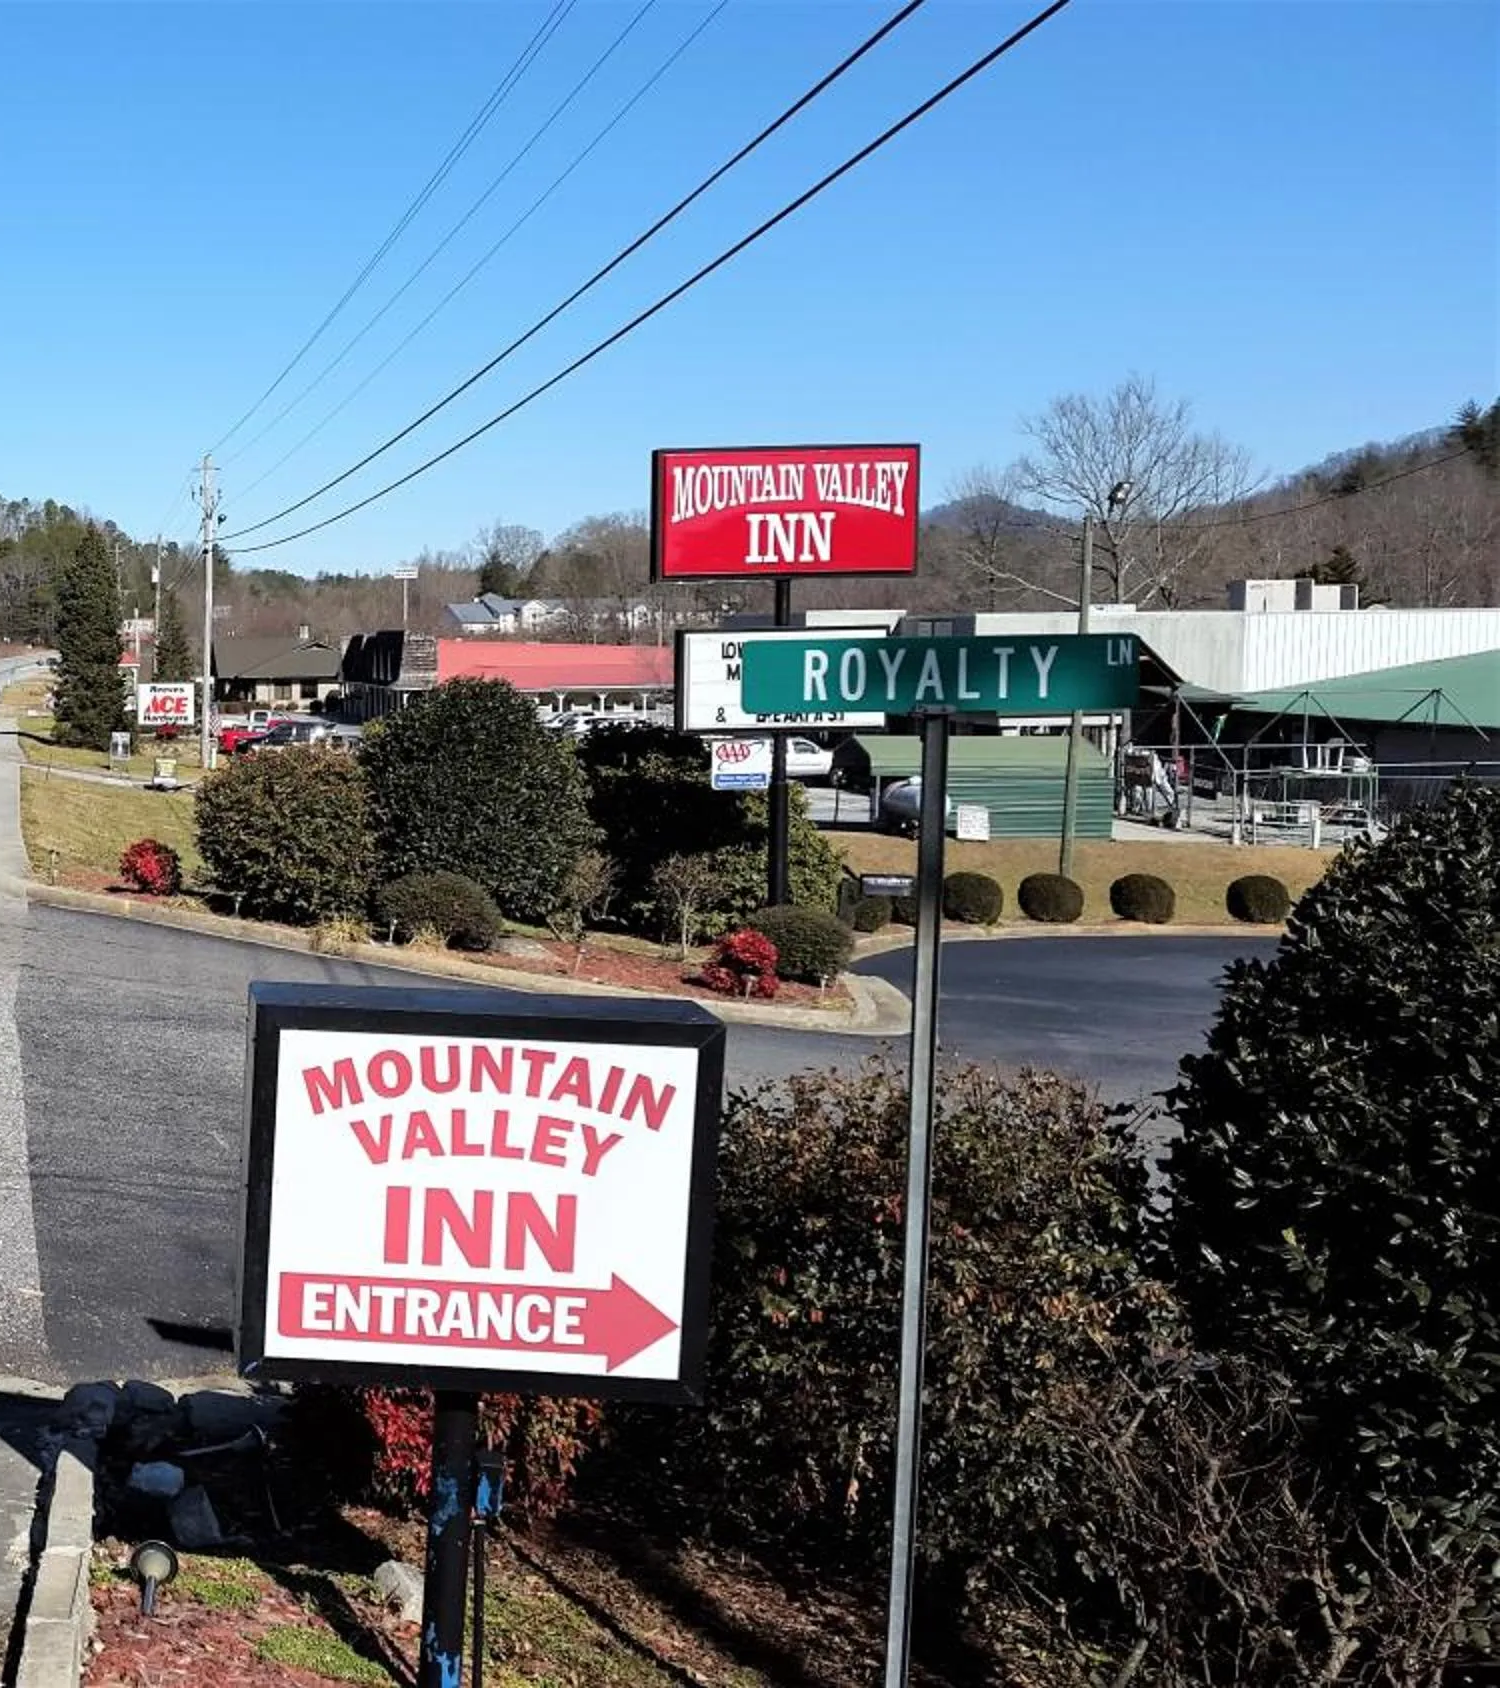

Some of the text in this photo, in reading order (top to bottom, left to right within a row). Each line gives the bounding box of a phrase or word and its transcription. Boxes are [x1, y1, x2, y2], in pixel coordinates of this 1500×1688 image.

[671, 461, 909, 524] MOUNTAIN VALLEY
[744, 511, 836, 563] INN
[803, 639, 1134, 701] ROYALTY LN
[144, 696, 188, 714] ACE
[715, 706, 727, 723] &
[716, 743, 750, 763] AAA
[302, 1045, 676, 1132] MOUNTAIN
[349, 1108, 624, 1177] VALLEY
[383, 1185, 578, 1274] INN
[300, 1281, 587, 1346] ENTRANCE
